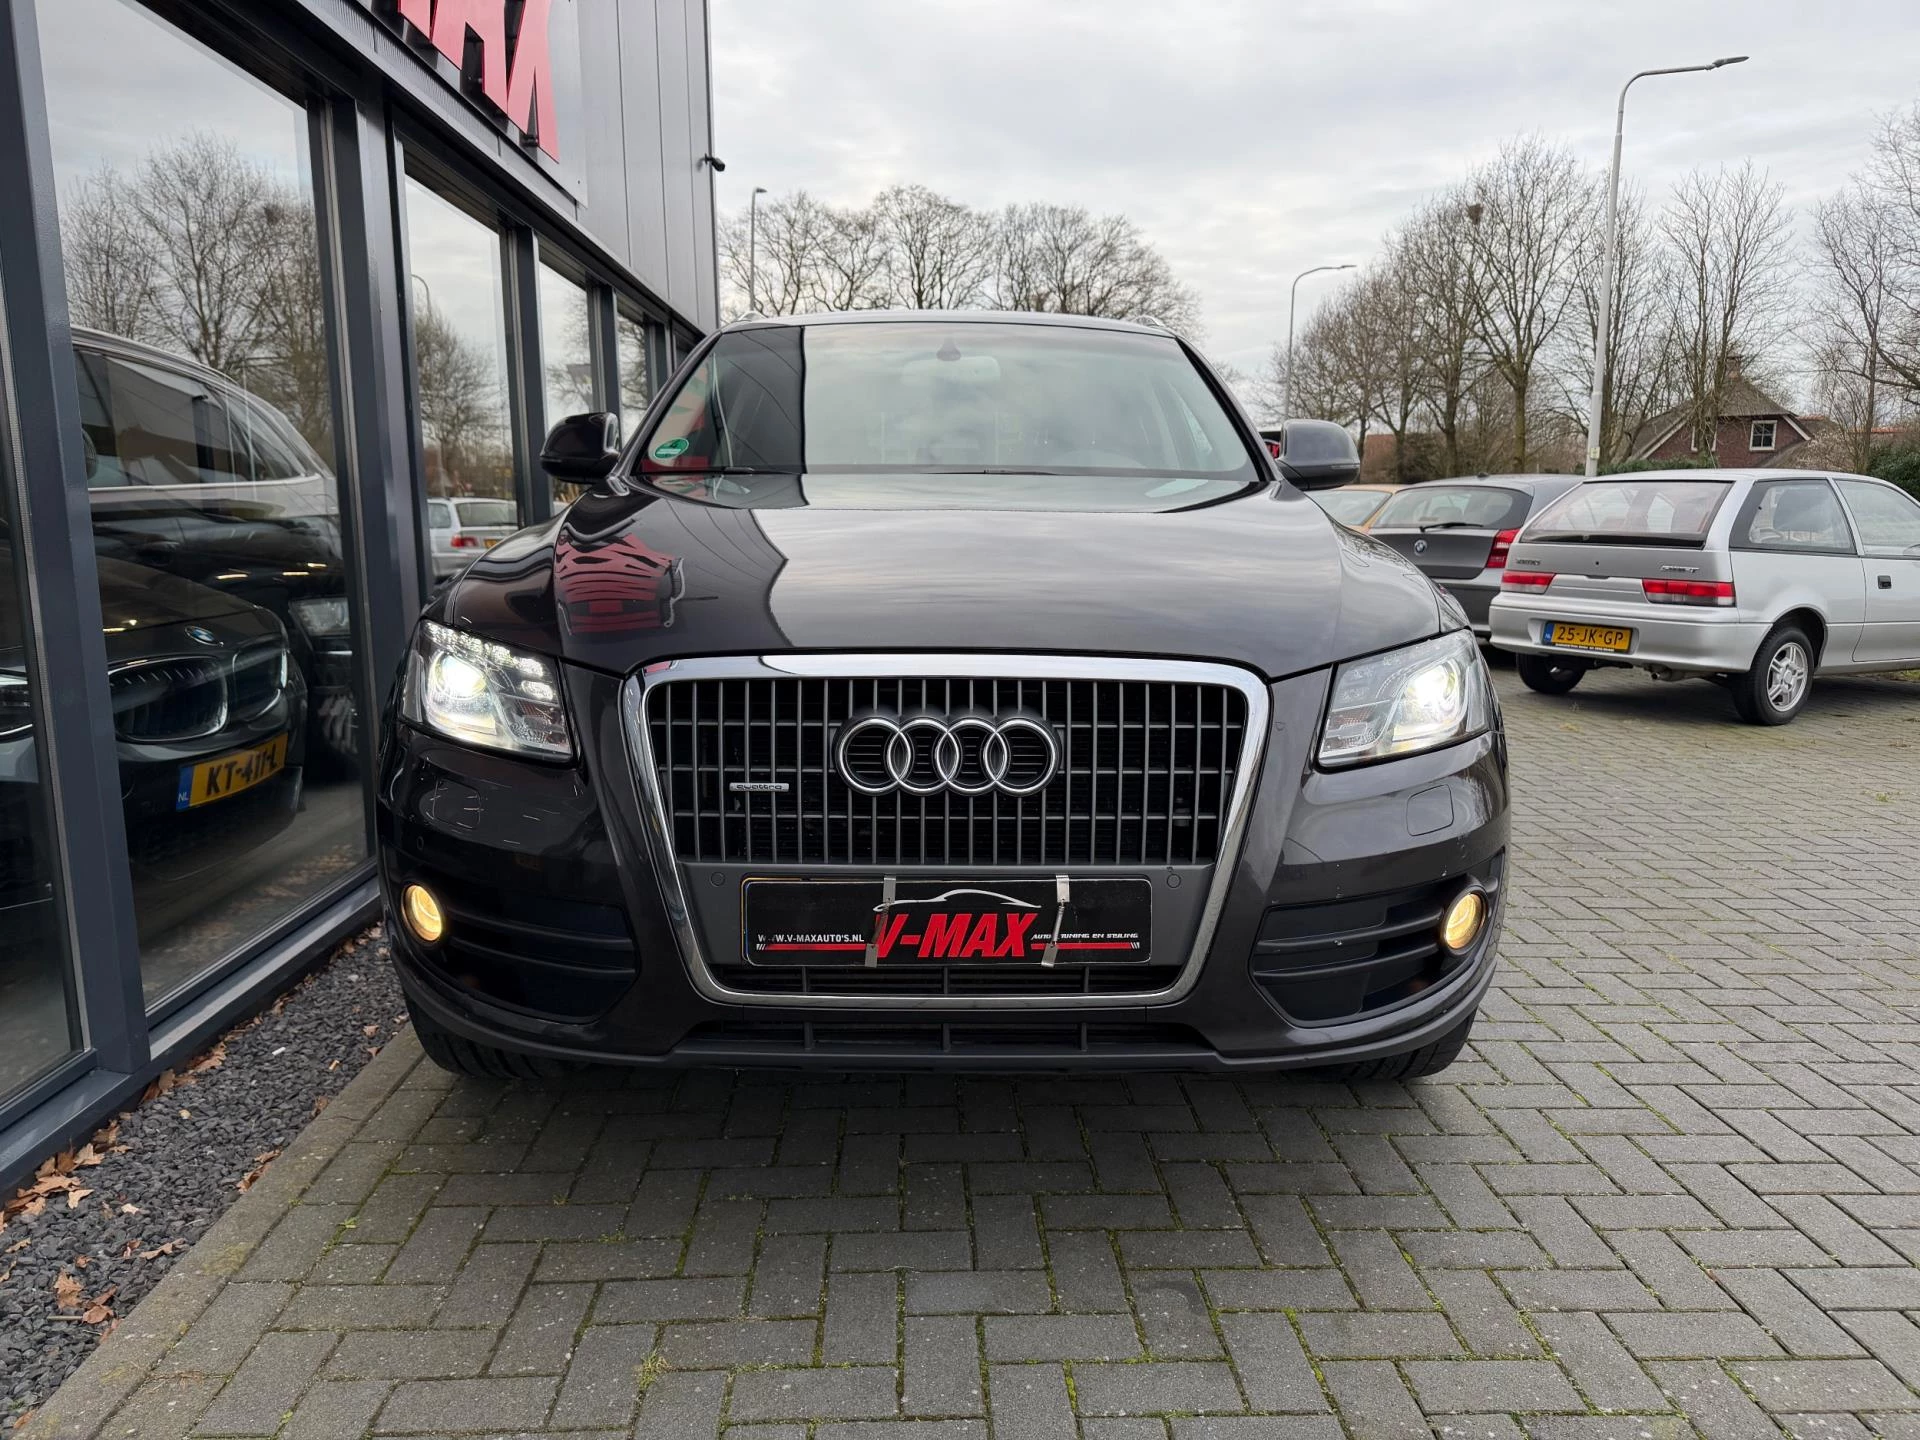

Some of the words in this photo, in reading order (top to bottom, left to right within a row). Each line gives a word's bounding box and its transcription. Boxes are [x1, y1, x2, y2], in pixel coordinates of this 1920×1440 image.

[1558, 626, 1624, 645] 25-JK-GP
[177, 791, 189, 802] NL
[758, 934, 865, 943] WW.V-MAXAUTO'S.NL
[875, 913, 1038, 958] V-MAX
